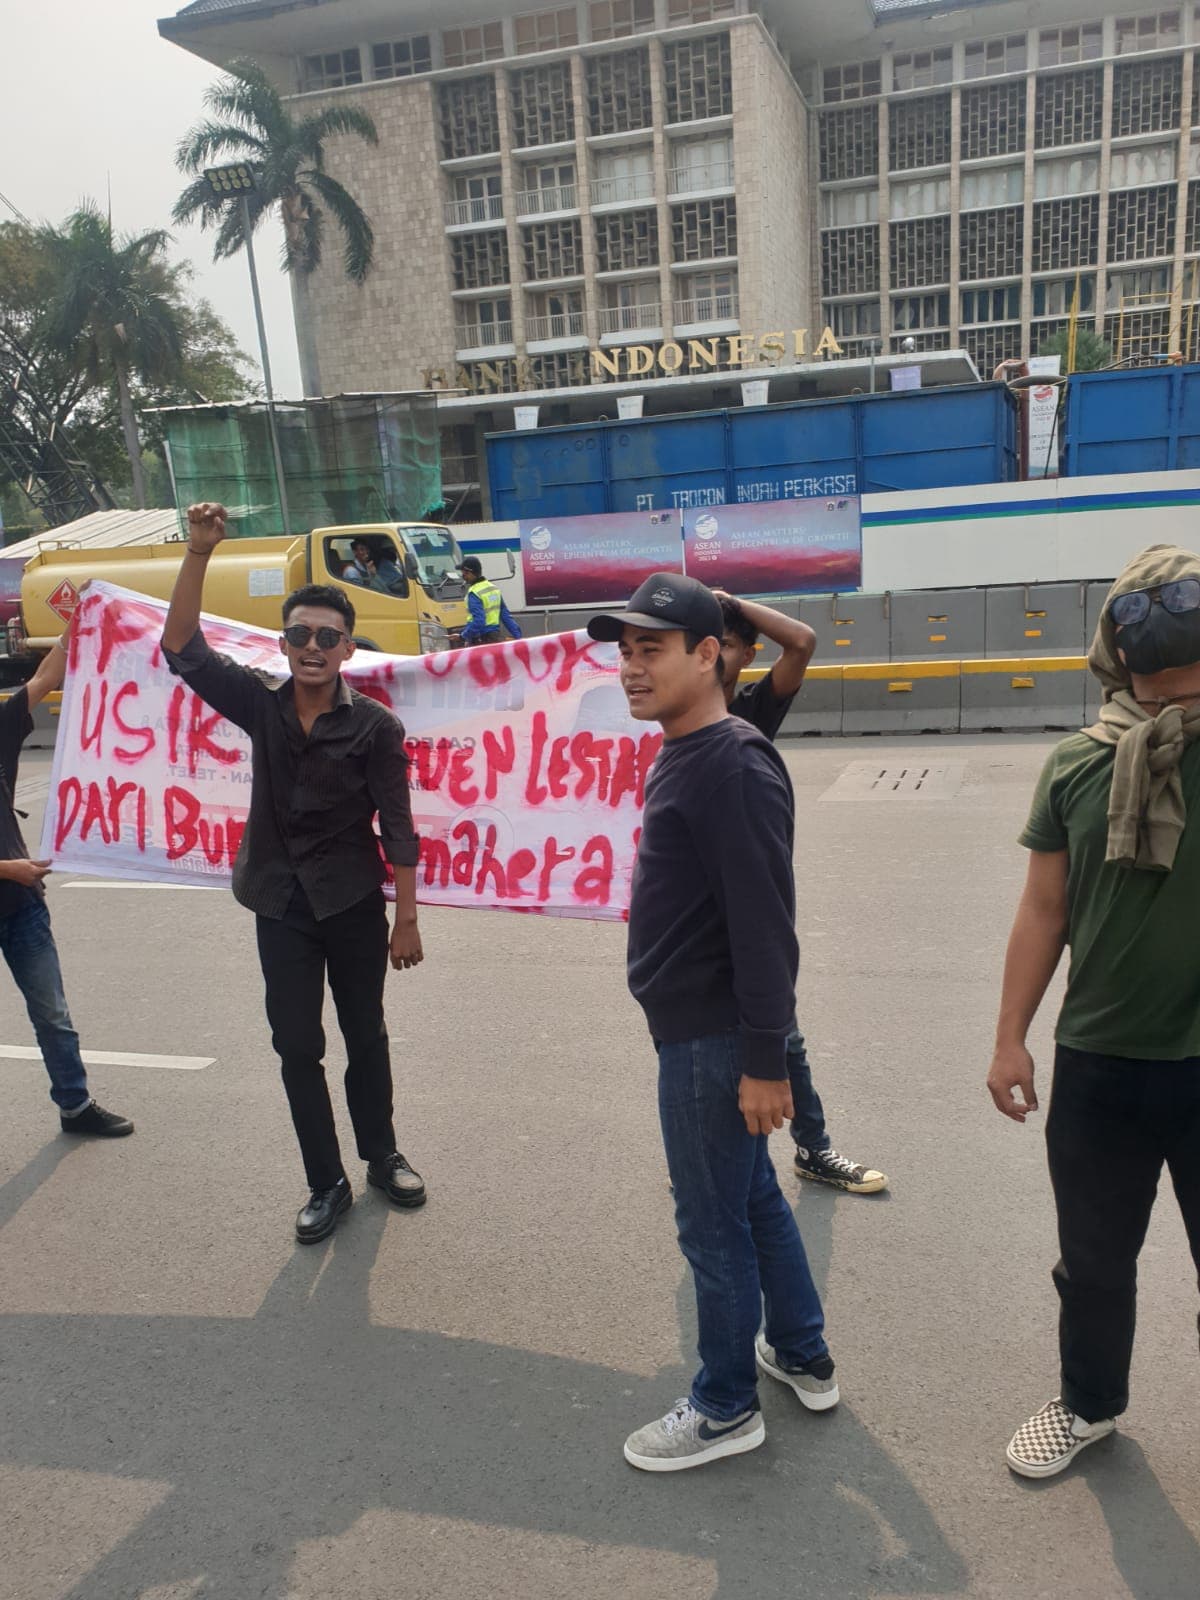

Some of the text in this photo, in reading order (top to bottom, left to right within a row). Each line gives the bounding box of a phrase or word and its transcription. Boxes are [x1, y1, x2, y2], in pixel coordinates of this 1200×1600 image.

[420, 326, 844, 393] BANK INDONESIA
[636, 493, 655, 512] PT
[784, 474, 856, 498] PERKASA
[529, 552, 555, 561] ASEAN
[694, 541, 721, 550] ASEAN
